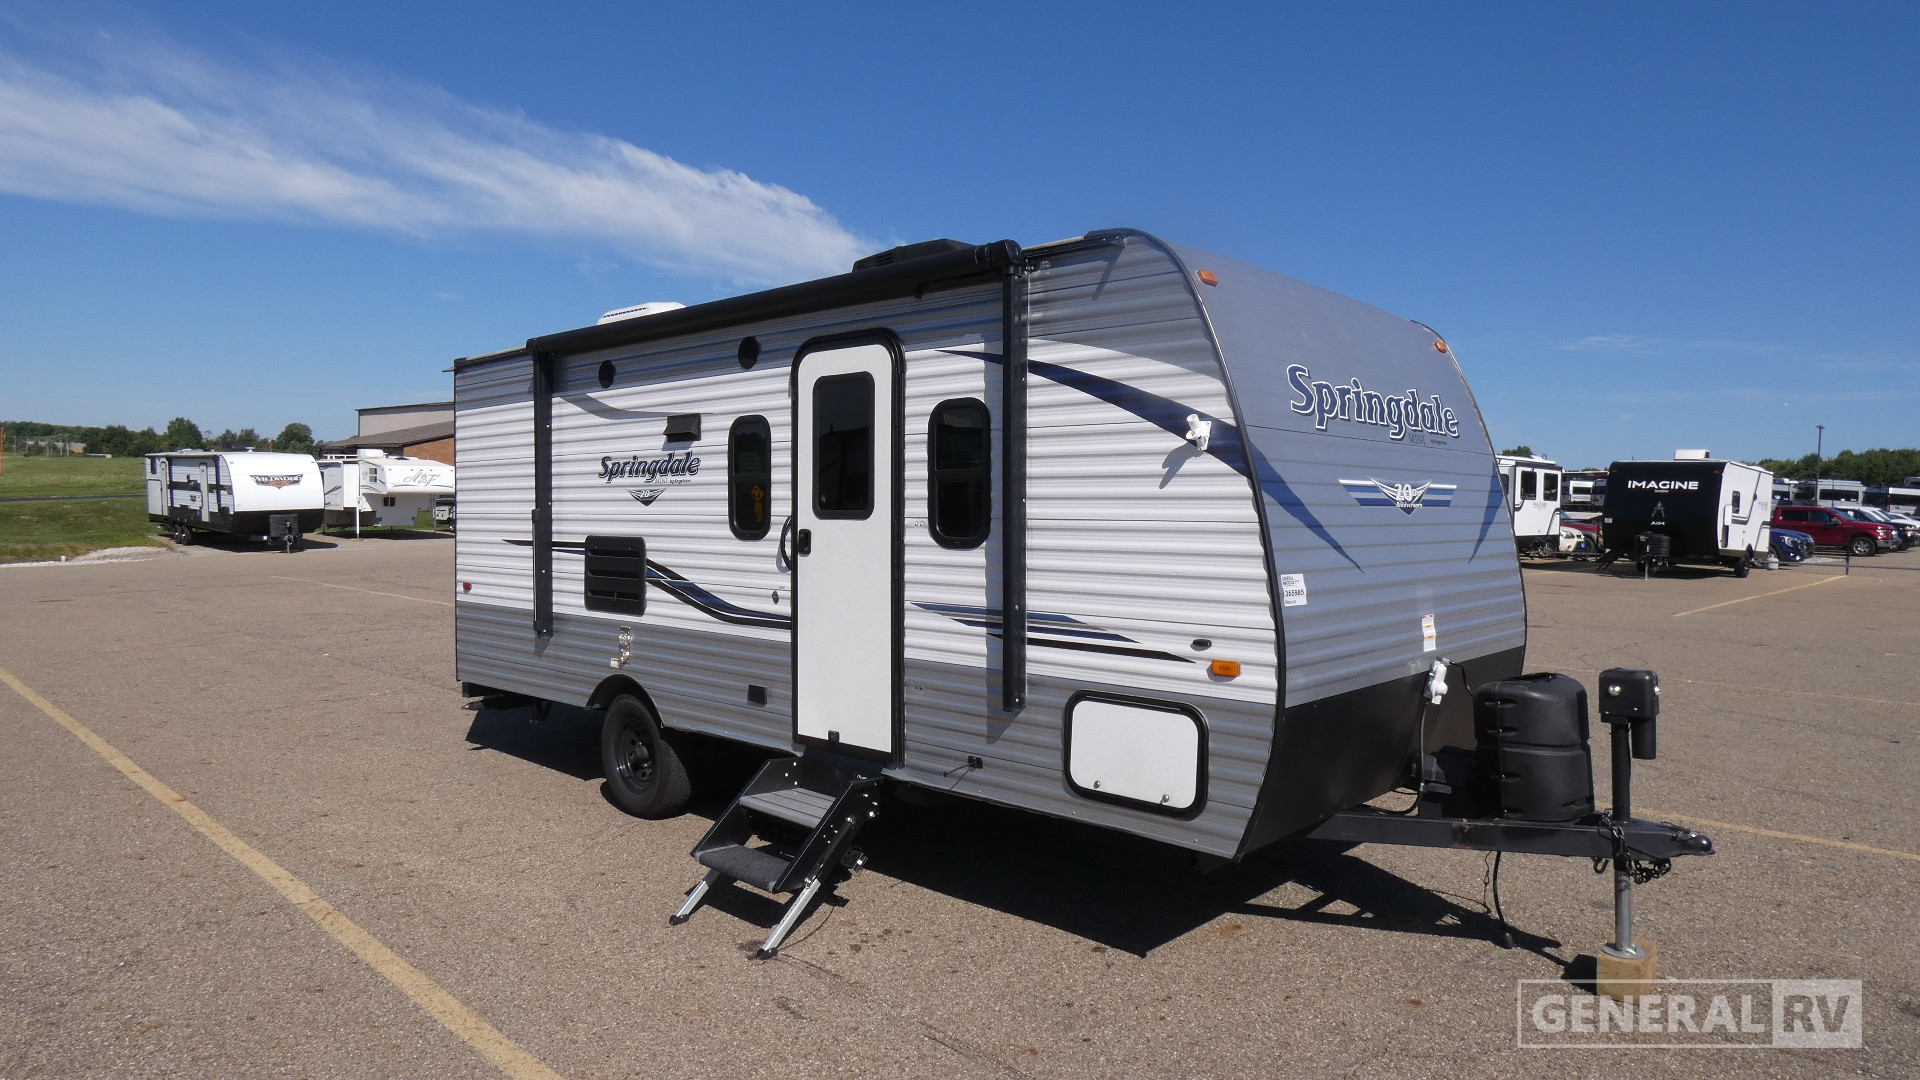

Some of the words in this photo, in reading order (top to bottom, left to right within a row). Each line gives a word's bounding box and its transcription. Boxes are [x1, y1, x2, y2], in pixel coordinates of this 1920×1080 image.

[1286, 363, 1460, 440] Springdale
[598, 451, 701, 484] Springdale
[1627, 480, 1699, 490] IMAGINE
